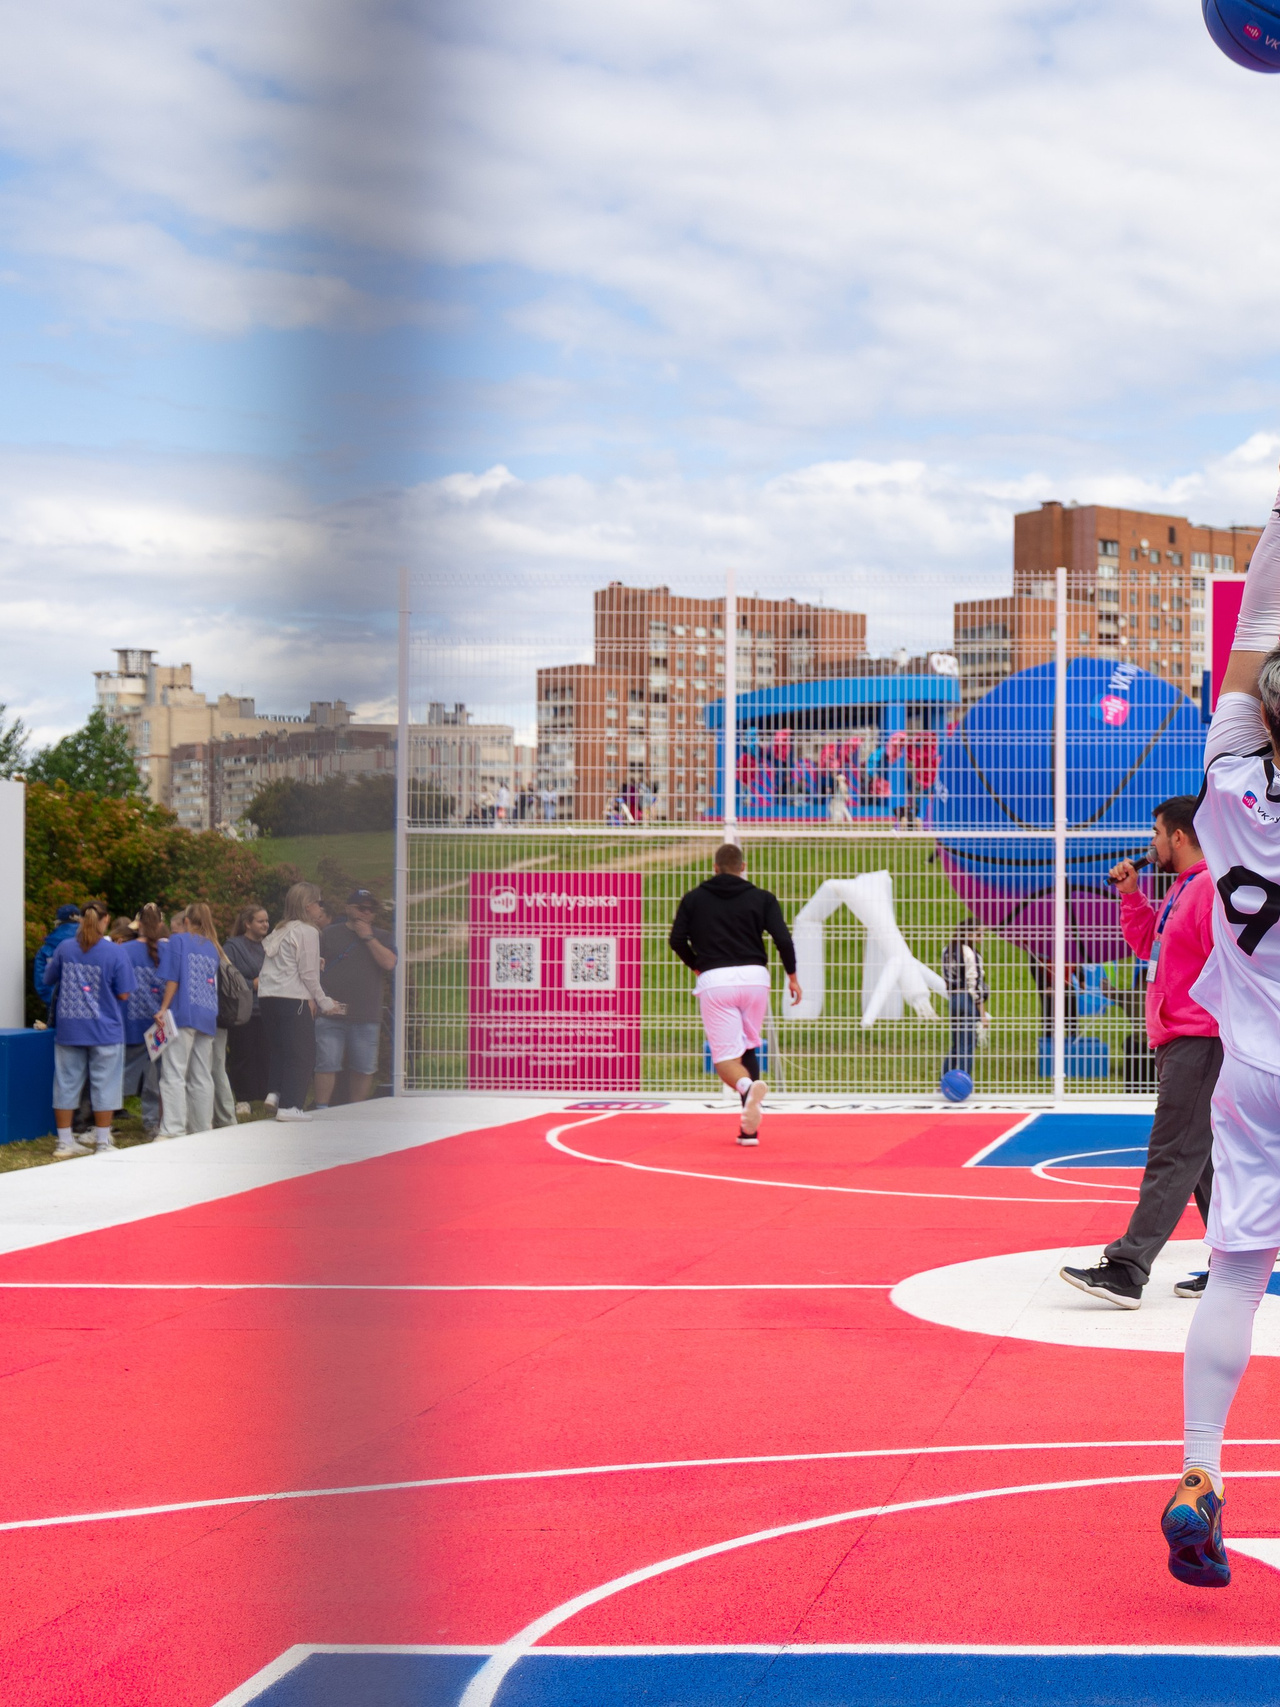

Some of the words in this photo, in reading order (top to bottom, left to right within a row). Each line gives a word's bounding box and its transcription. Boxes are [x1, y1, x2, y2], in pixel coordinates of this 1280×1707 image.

[1265, 34, 1280, 50] VK
[523, 892, 548, 907] VK
[551, 892, 618, 911] Музыка
[803, 1103, 1056, 1112] Музыка
